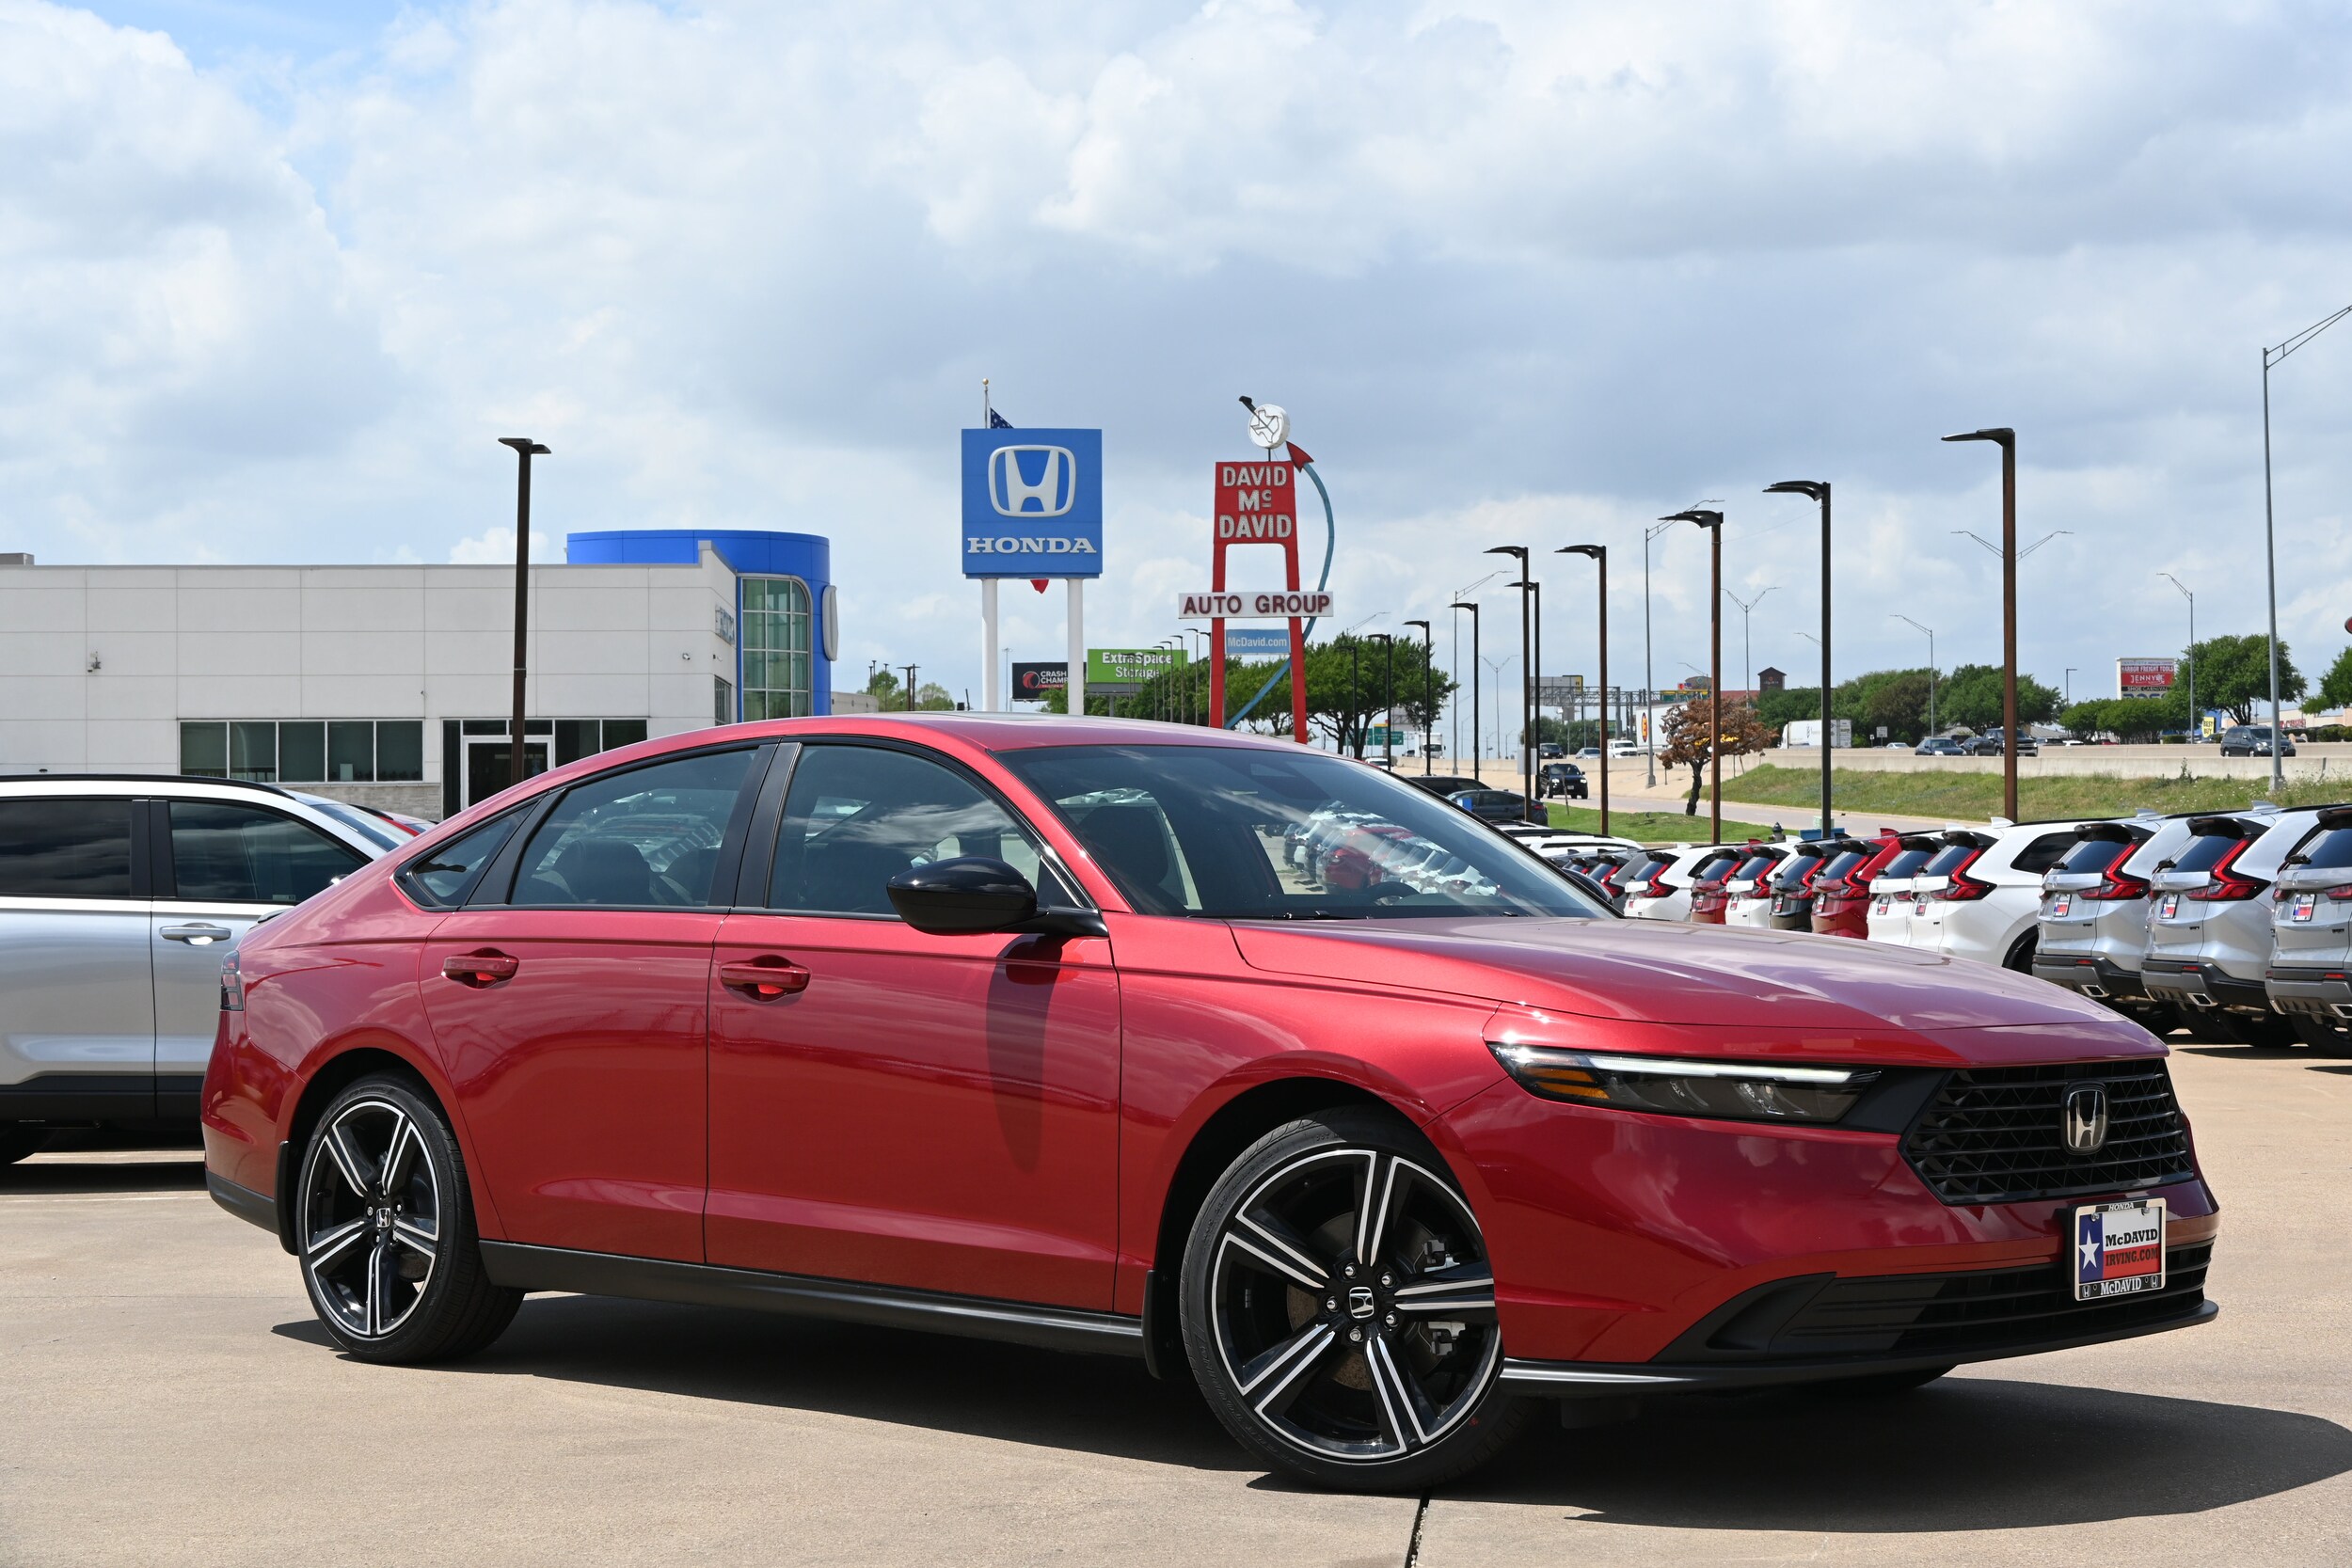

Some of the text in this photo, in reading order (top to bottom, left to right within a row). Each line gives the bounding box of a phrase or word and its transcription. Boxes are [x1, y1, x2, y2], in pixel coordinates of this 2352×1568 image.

[1222, 466, 1287, 487] DAVID
[1219, 515, 1292, 538] DAVID
[967, 537, 1097, 553] HONDA
[1183, 594, 1330, 614] AUTO GROUP
[1228, 636, 1287, 647] McDavid.com
[1115, 666, 1160, 679] Storage
[2107, 1202, 2135, 1212] HONDA
[2106, 1228, 2158, 1247] McDAVID
[2106, 1247, 2159, 1266] IRVING.COM
[2100, 1277, 2142, 1295] McDAVID
